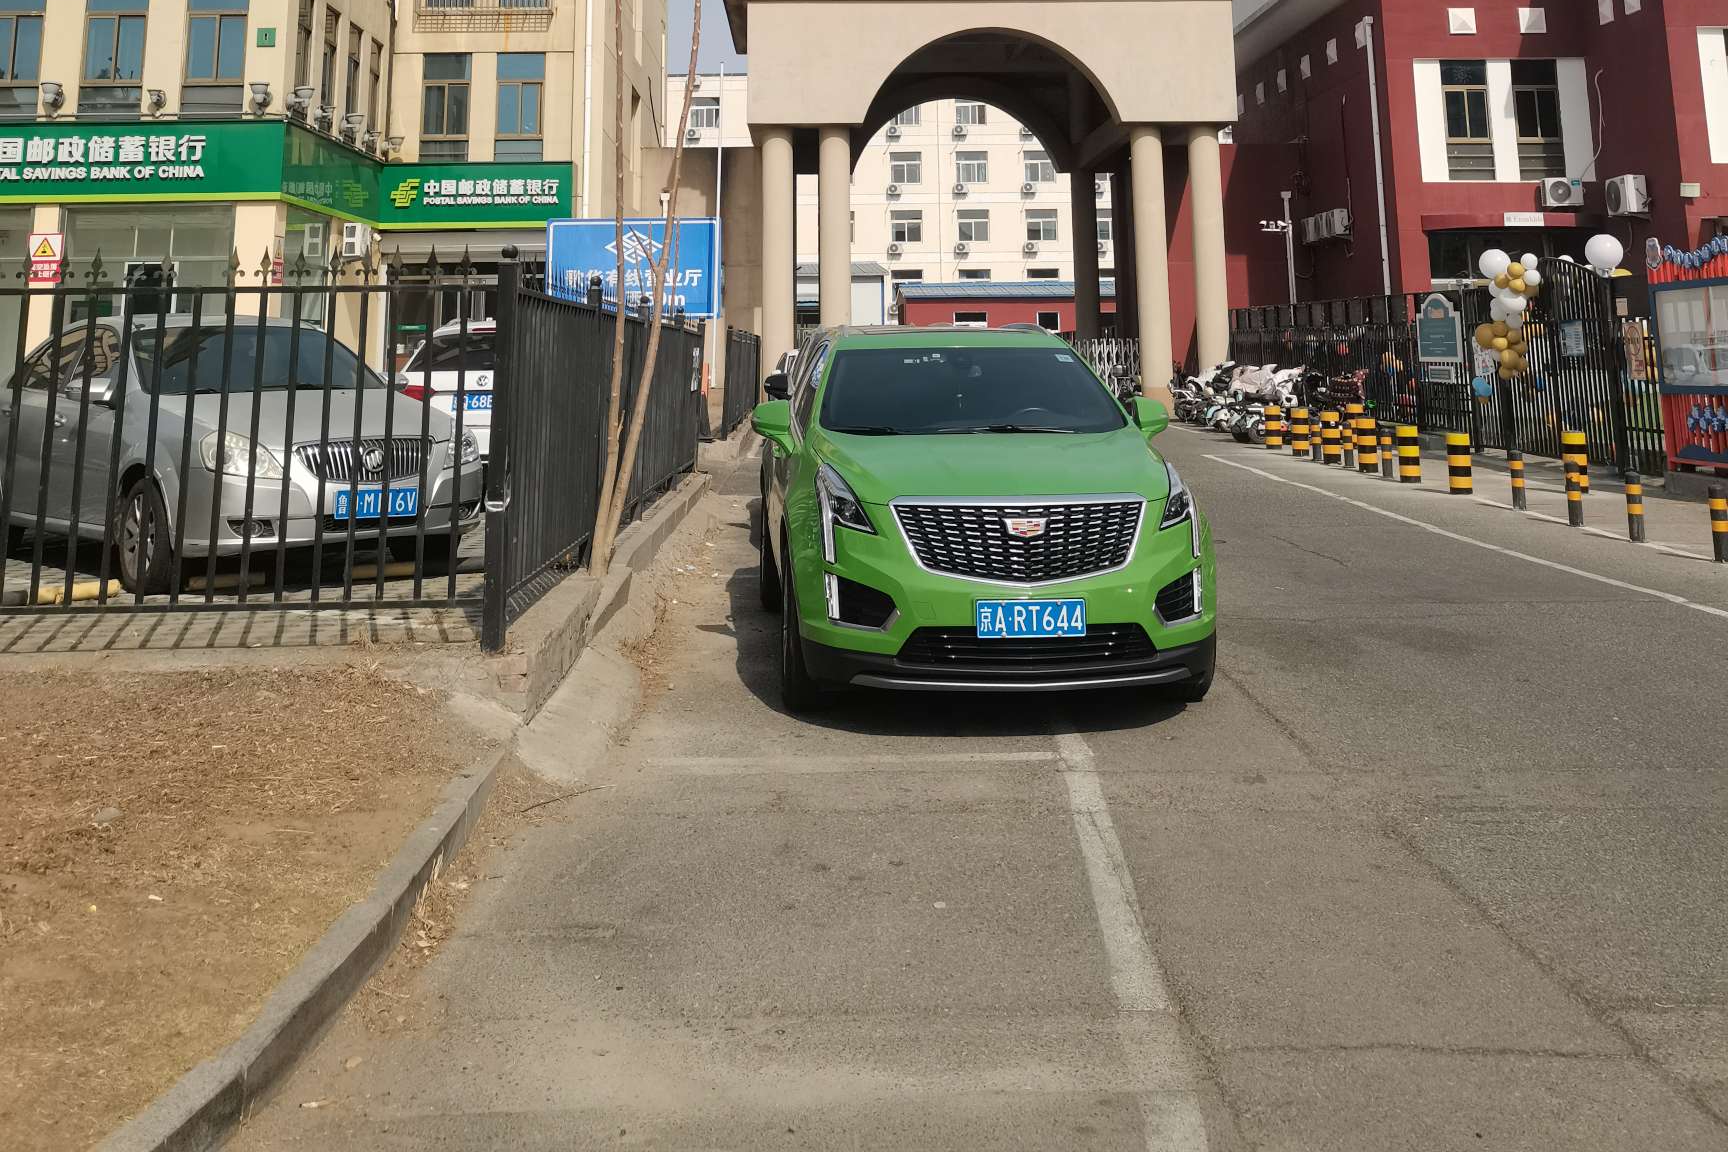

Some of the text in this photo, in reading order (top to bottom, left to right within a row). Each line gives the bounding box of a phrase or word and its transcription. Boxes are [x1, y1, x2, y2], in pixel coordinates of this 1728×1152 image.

[0, 135, 206, 163] 国邮政储蓄银行
[23, 167, 87, 180] SAVINGS
[90, 166, 132, 179] BANK
[134, 166, 155, 179] OF
[158, 165, 205, 178] CHINA
[423, 179, 560, 196] 中国邮政储蓄银行
[423, 196, 559, 205] POSTAL SAVINGS BANK OF CHINA
